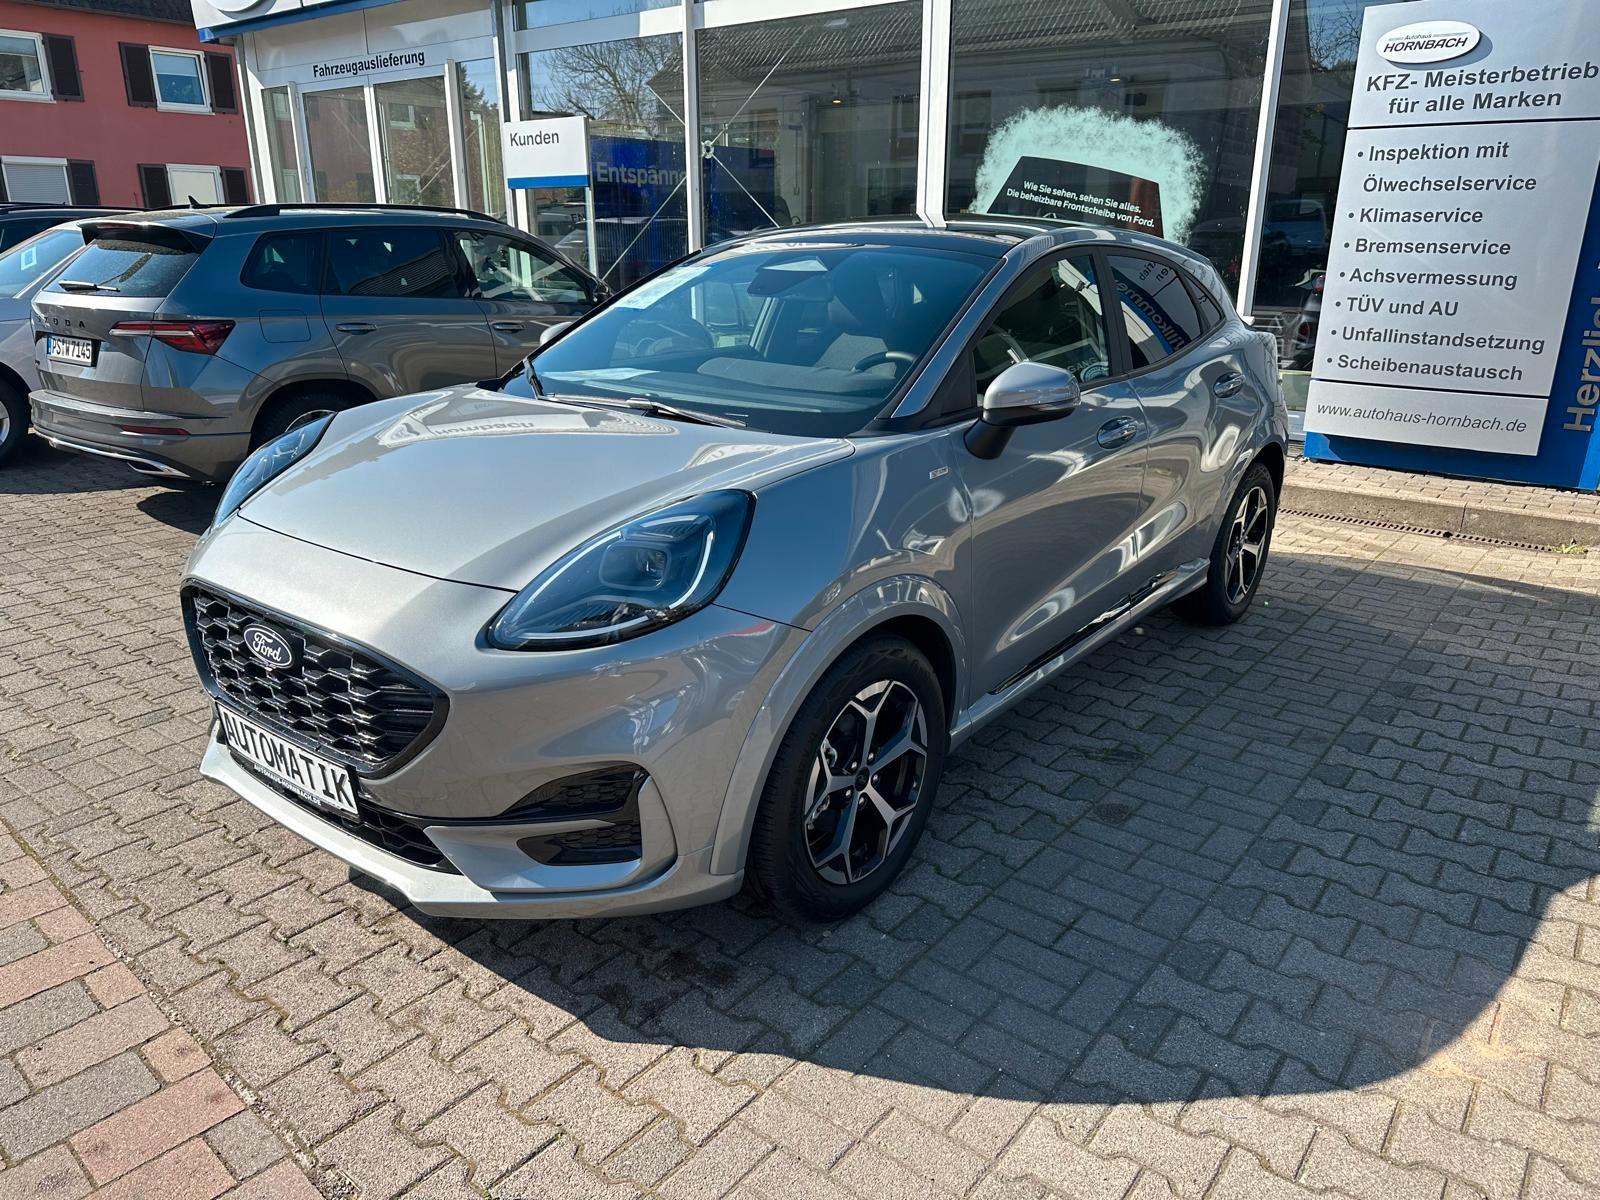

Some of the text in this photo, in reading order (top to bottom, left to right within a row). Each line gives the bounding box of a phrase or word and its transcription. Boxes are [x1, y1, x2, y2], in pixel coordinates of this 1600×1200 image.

[1383, 37, 1469, 53] HORNBACH
[312, 51, 425, 77] Fahrzeugauslieferung
[1366, 61, 1599, 92] KFZ- Meisterbetrieb
[1388, 90, 1562, 114] für alle Marken
[509, 130, 560, 147] Kunden
[1368, 141, 1510, 164] Inspektion mit
[1362, 173, 1537, 193] Ölwechselservice
[1006, 188, 1155, 228] Die beheizbare Frontscheibe von Ford.
[1023, 181, 1142, 213] Wie Sie sehen, sehen Sie alles.
[1359, 207, 1484, 224] Klimaservice
[1355, 238, 1511, 256] Bremsenservice
[1349, 267, 1518, 291] Achsvermessung
[1347, 294, 1459, 317] TÜV und AU
[52, 337, 62, 355] PS
[71, 340, 91, 360] 7145
[1342, 326, 1545, 355] Unfallinstandsetzung
[1337, 354, 1523, 381] Scheibenaustausch
[1563, 297, 1600, 433] Herzli
[1317, 402, 1527, 433] www.autohaus-hornbach.de
[252, 631, 282, 662] Ford
[223, 711, 356, 810] AUTOMATIK
